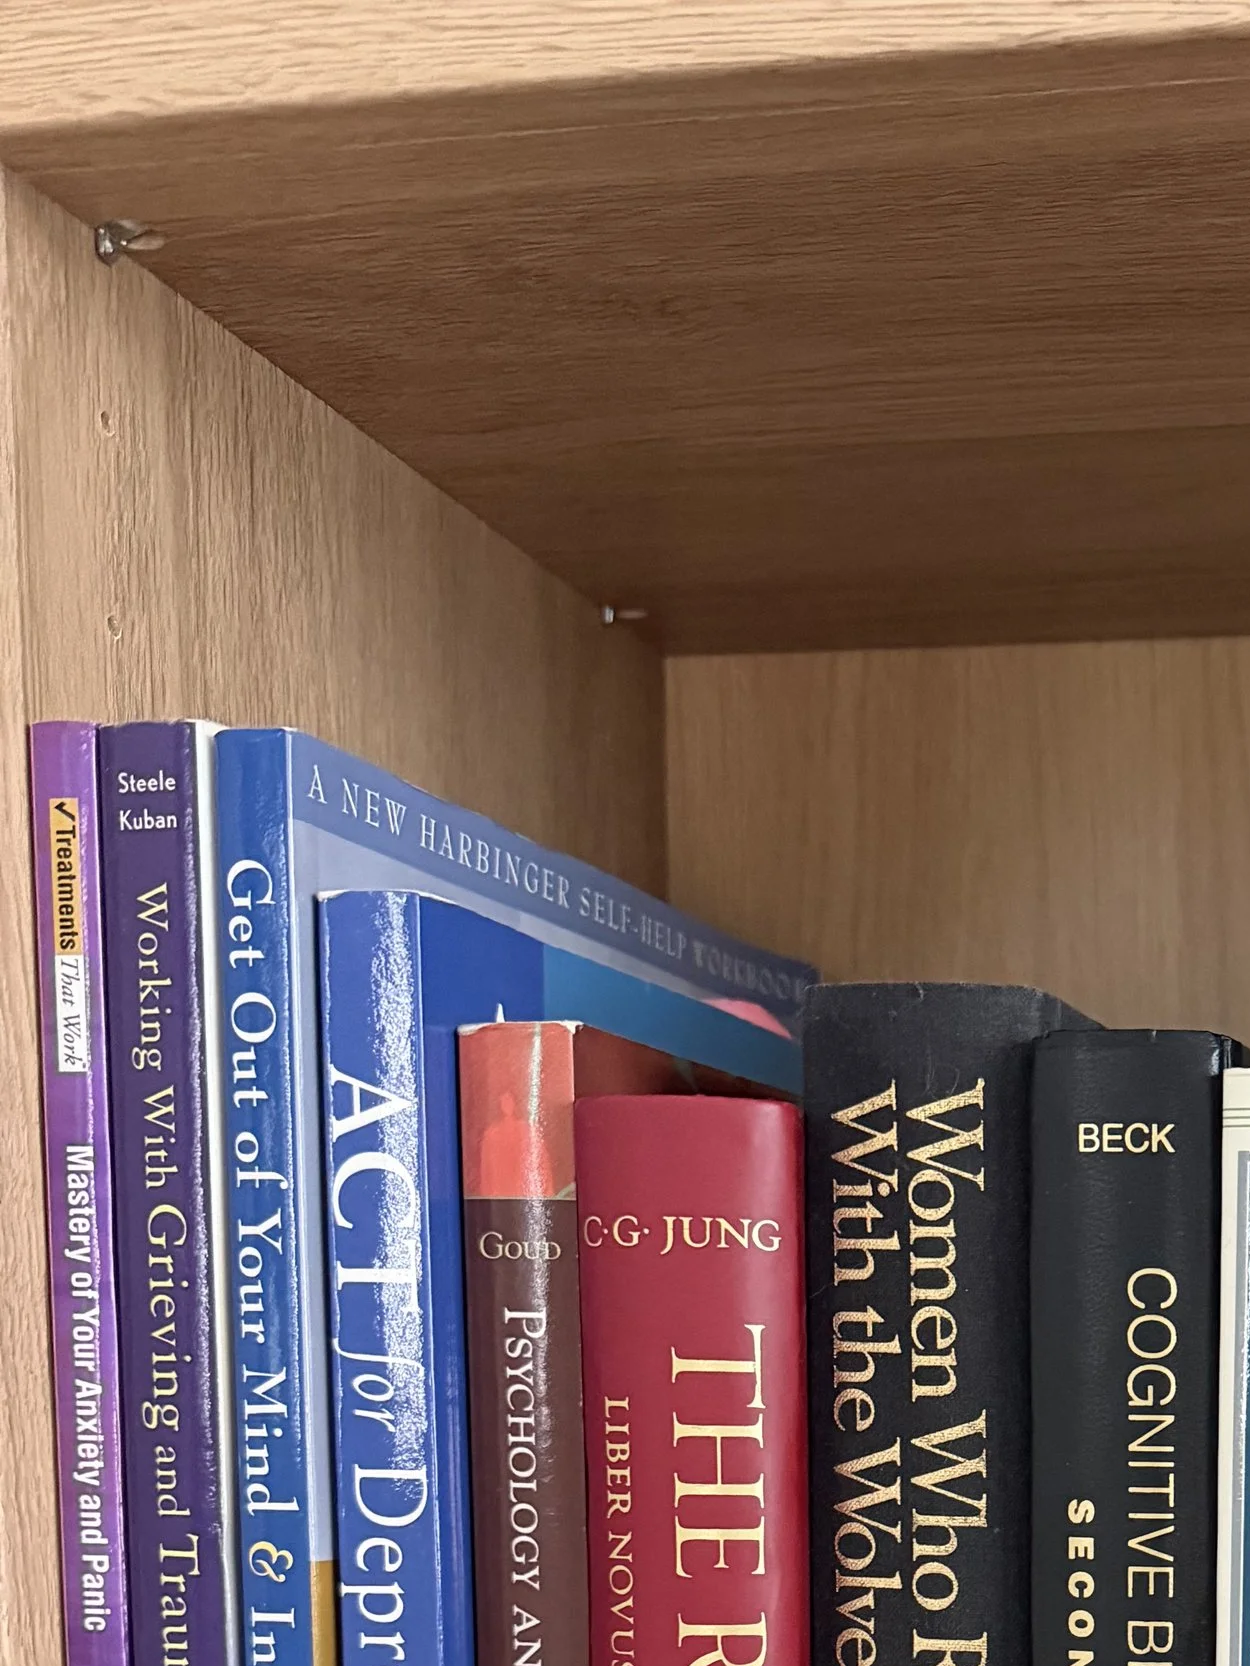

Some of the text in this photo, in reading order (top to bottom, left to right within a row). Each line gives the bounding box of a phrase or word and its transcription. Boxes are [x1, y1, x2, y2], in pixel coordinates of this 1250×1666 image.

[118, 771, 177, 795] Steele
[119, 810, 178, 831] Kuban
[226, 858, 277, 968] Get
[307, 764, 687, 961] A NEW HARBINGER SELF-HELP
[55, 824, 82, 1067] Treatments That Work
[131, 882, 168, 1072] Working
[230, 991, 277, 1110] Out
[144, 1085, 178, 1189] With
[234, 1130, 288, 1189] of
[330, 1064, 422, 1313] ACT
[830, 1077, 900, 1286] With
[1077, 1122, 1176, 1154] BECK
[236, 1211, 284, 1345] Your
[660, 1216, 782, 1255] JUNG
[905, 1077, 986, 1403] Women
[66, 1145, 112, 1633] Mastery of Your Anxiety and Panic
[142, 1205, 190, 1432] Grieving
[332, 1339, 426, 1432] for
[832, 1305, 901, 1433] the
[155, 1446, 190, 1519] and
[244, 1364, 299, 1517] Mind
[504, 1306, 547, 1591] PSYCHOLOGY
[604, 1397, 632, 1519] LIBER
[670, 1324, 767, 1578] THE
[1126, 1267, 1178, 1599] COGNITIVE
[911, 1408, 988, 1612] Who
